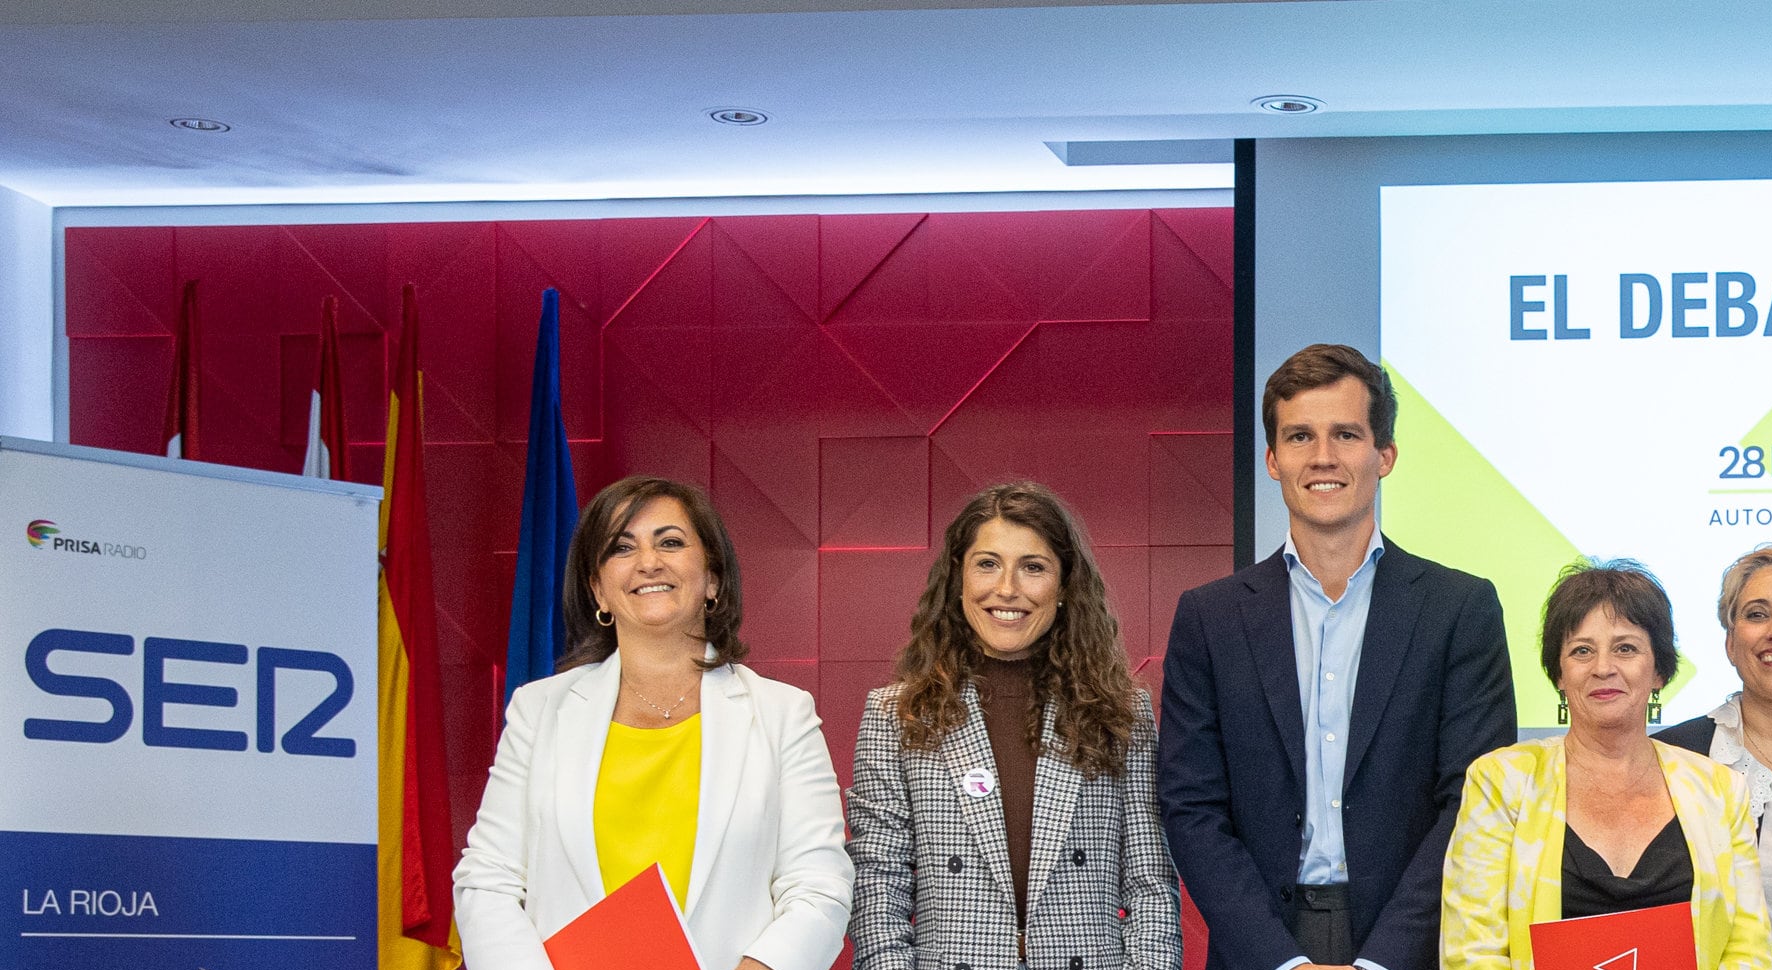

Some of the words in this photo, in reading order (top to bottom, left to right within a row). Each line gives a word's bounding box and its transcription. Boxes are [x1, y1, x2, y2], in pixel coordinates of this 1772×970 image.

[1509, 274, 1591, 341] EL
[54, 536, 101, 556] PRISA
[103, 542, 147, 560] RADIO
[23, 628, 357, 758] SER
[22, 889, 61, 916] LA
[70, 889, 159, 917] RIOJA
